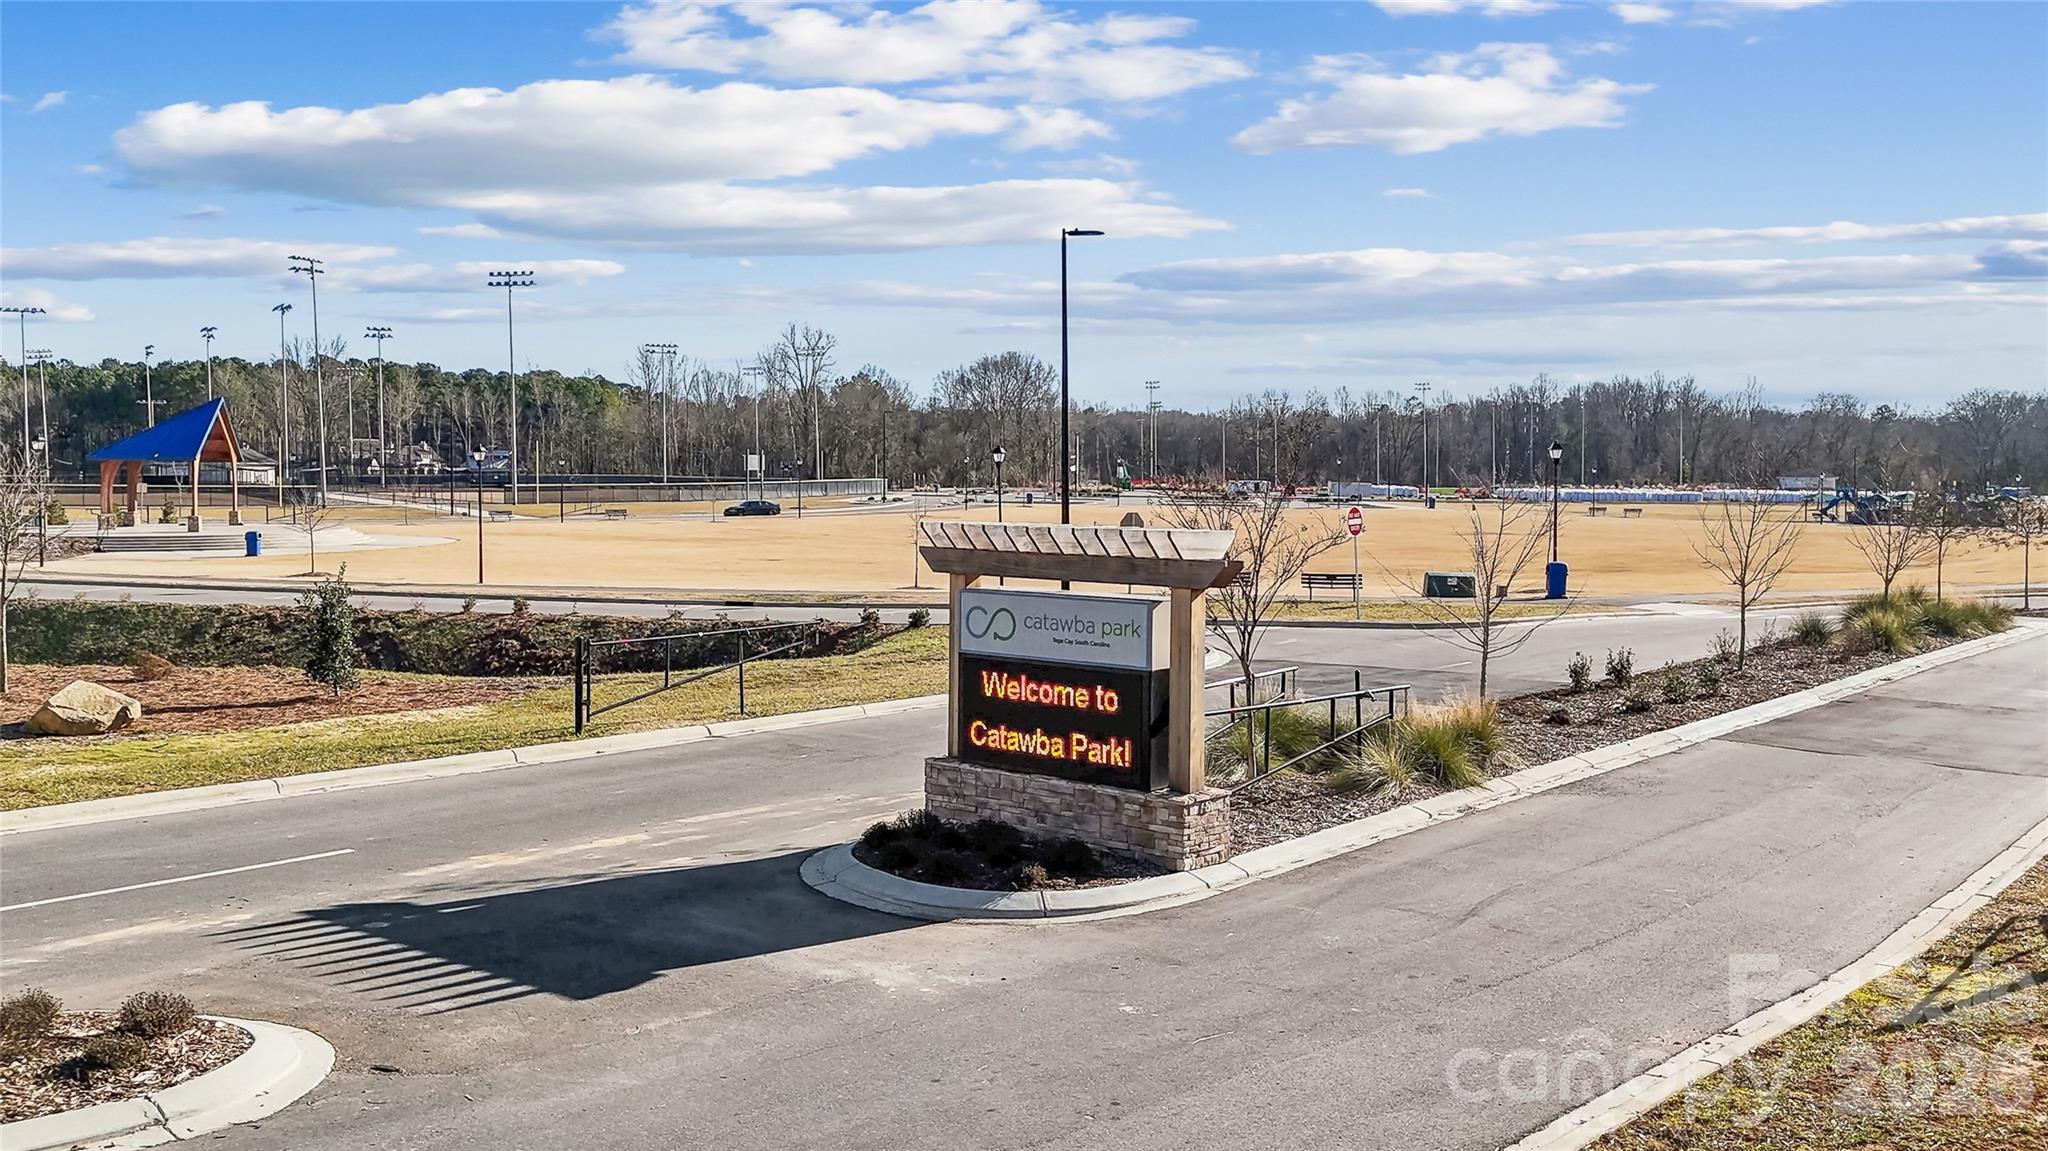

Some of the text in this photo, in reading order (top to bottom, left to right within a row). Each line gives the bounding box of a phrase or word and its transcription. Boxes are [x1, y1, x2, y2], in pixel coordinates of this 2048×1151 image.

[1024, 613, 1142, 639] catawba park
[981, 670, 1119, 712] Welcome to
[970, 720, 1133, 768] Catawba Park!
